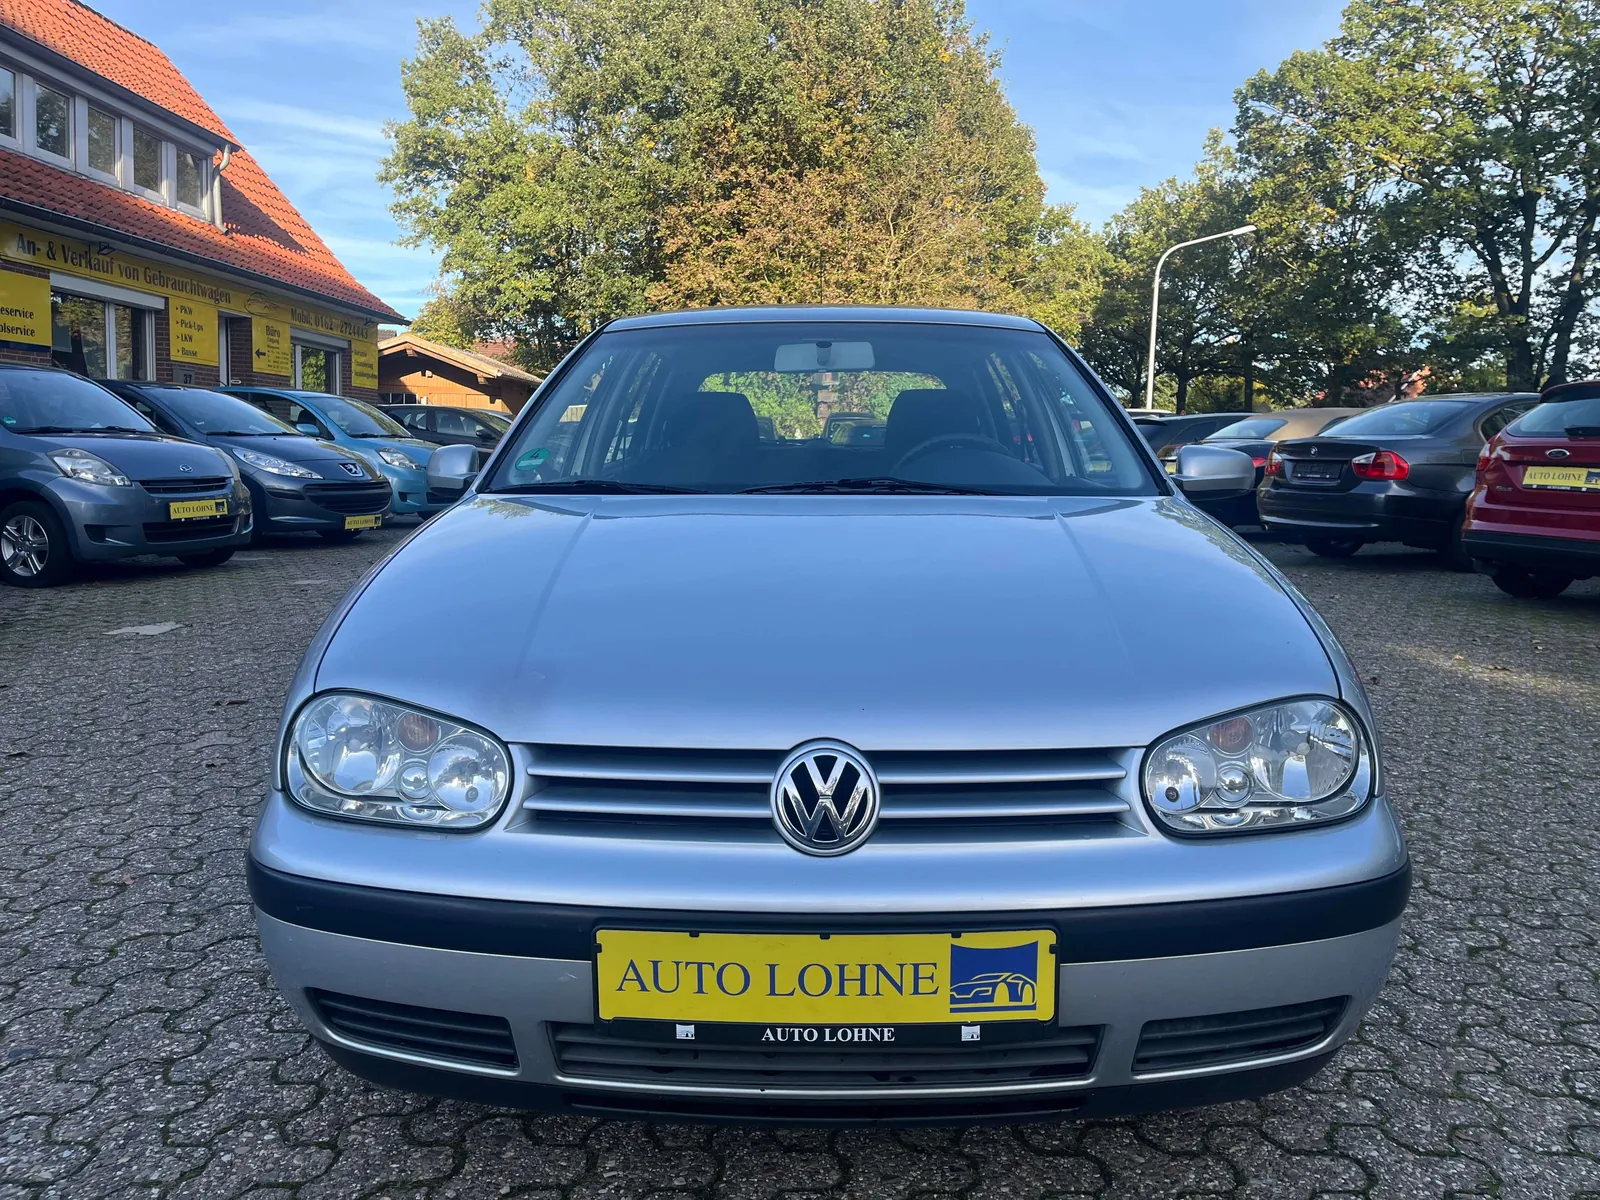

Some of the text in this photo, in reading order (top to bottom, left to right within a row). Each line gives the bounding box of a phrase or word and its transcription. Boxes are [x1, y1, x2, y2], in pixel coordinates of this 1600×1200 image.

[17, 233, 231, 305] An- & Verkauf von Gebrauchtwagen
[180, 305, 193, 316] PKW
[315, 315, 334, 330] 0162
[181, 333, 193, 343] LKW
[183, 374, 192, 384] 37
[1528, 472, 1584, 481] AUTO LOHNE
[173, 505, 214, 514] AUTO LOHNE
[616, 959, 939, 998] AUTO LOHNE
[762, 1027, 895, 1042] AUTO LOHNE
